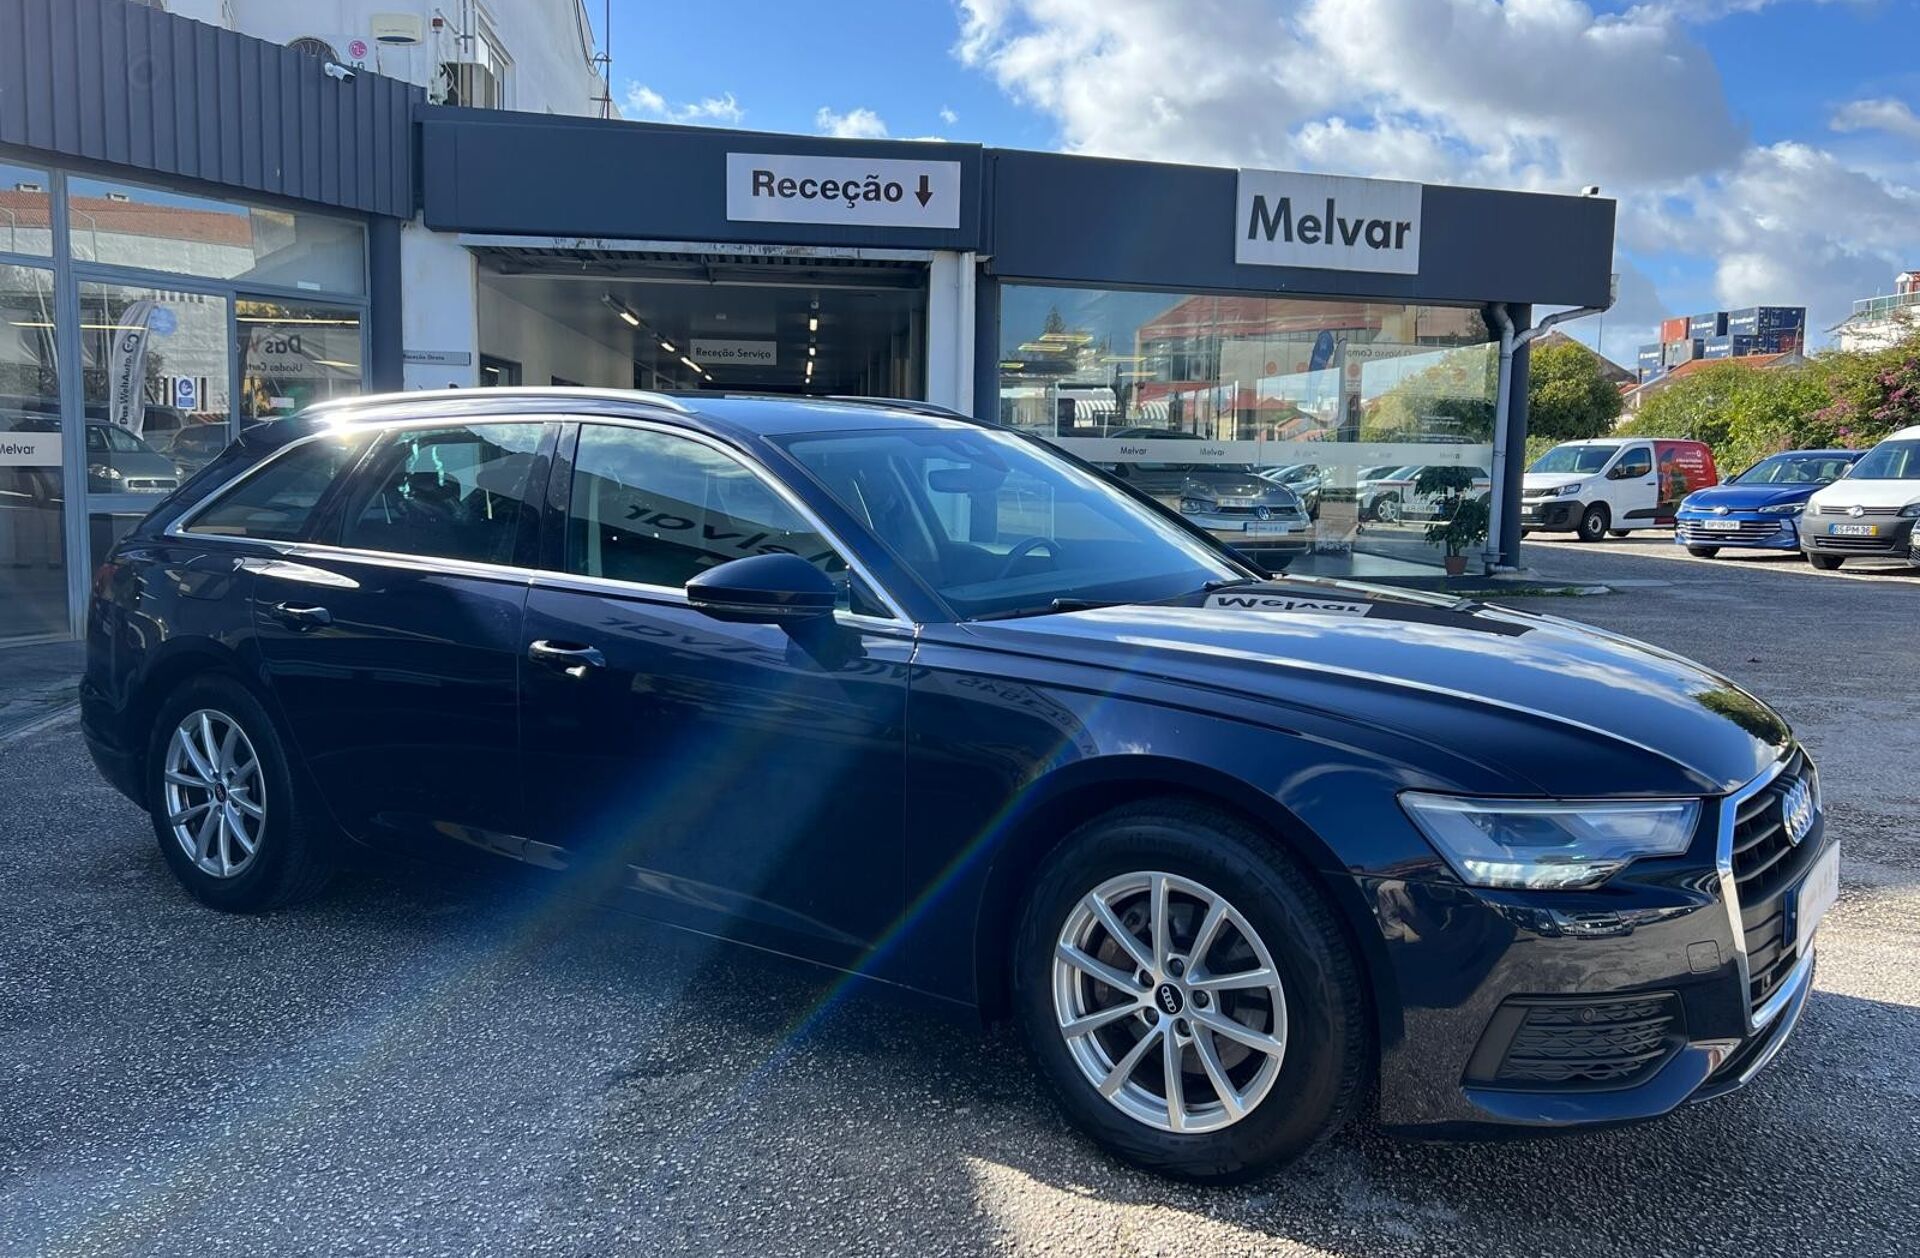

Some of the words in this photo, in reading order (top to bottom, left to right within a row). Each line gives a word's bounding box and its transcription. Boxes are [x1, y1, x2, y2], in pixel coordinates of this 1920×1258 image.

[752, 170, 903, 209] Receção
[1248, 195, 1412, 249] Melvar
[696, 347, 735, 358] Receção
[737, 348, 771, 359] Serviço
[1120, 446, 1147, 456] Melvar
